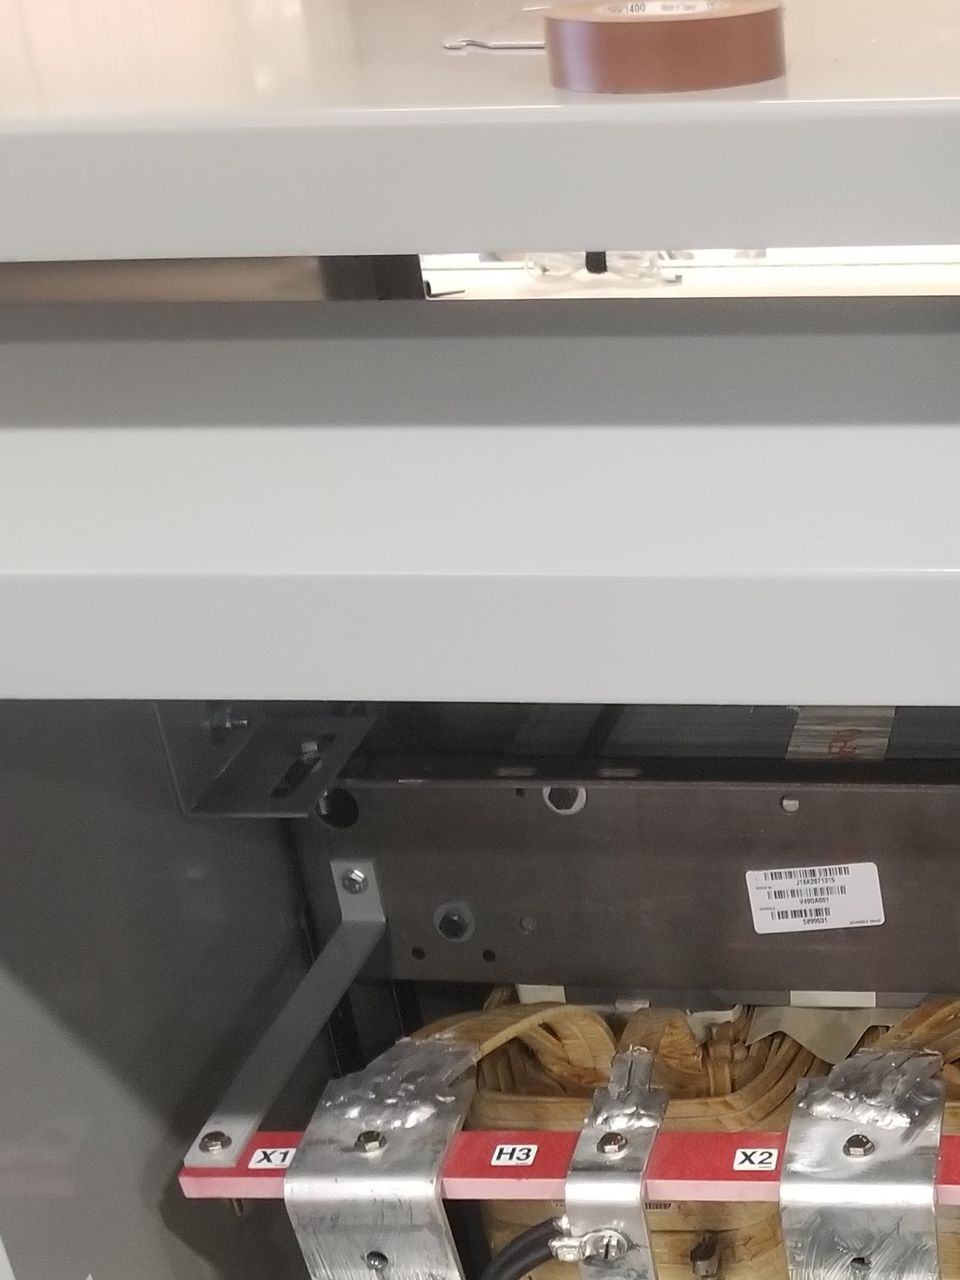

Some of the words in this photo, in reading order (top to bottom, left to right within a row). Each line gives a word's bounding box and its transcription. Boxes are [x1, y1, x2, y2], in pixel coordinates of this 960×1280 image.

[256, 1150, 290, 1164] X1
[495, 1147, 532, 1162] H3
[738, 1151, 774, 1165] X2
